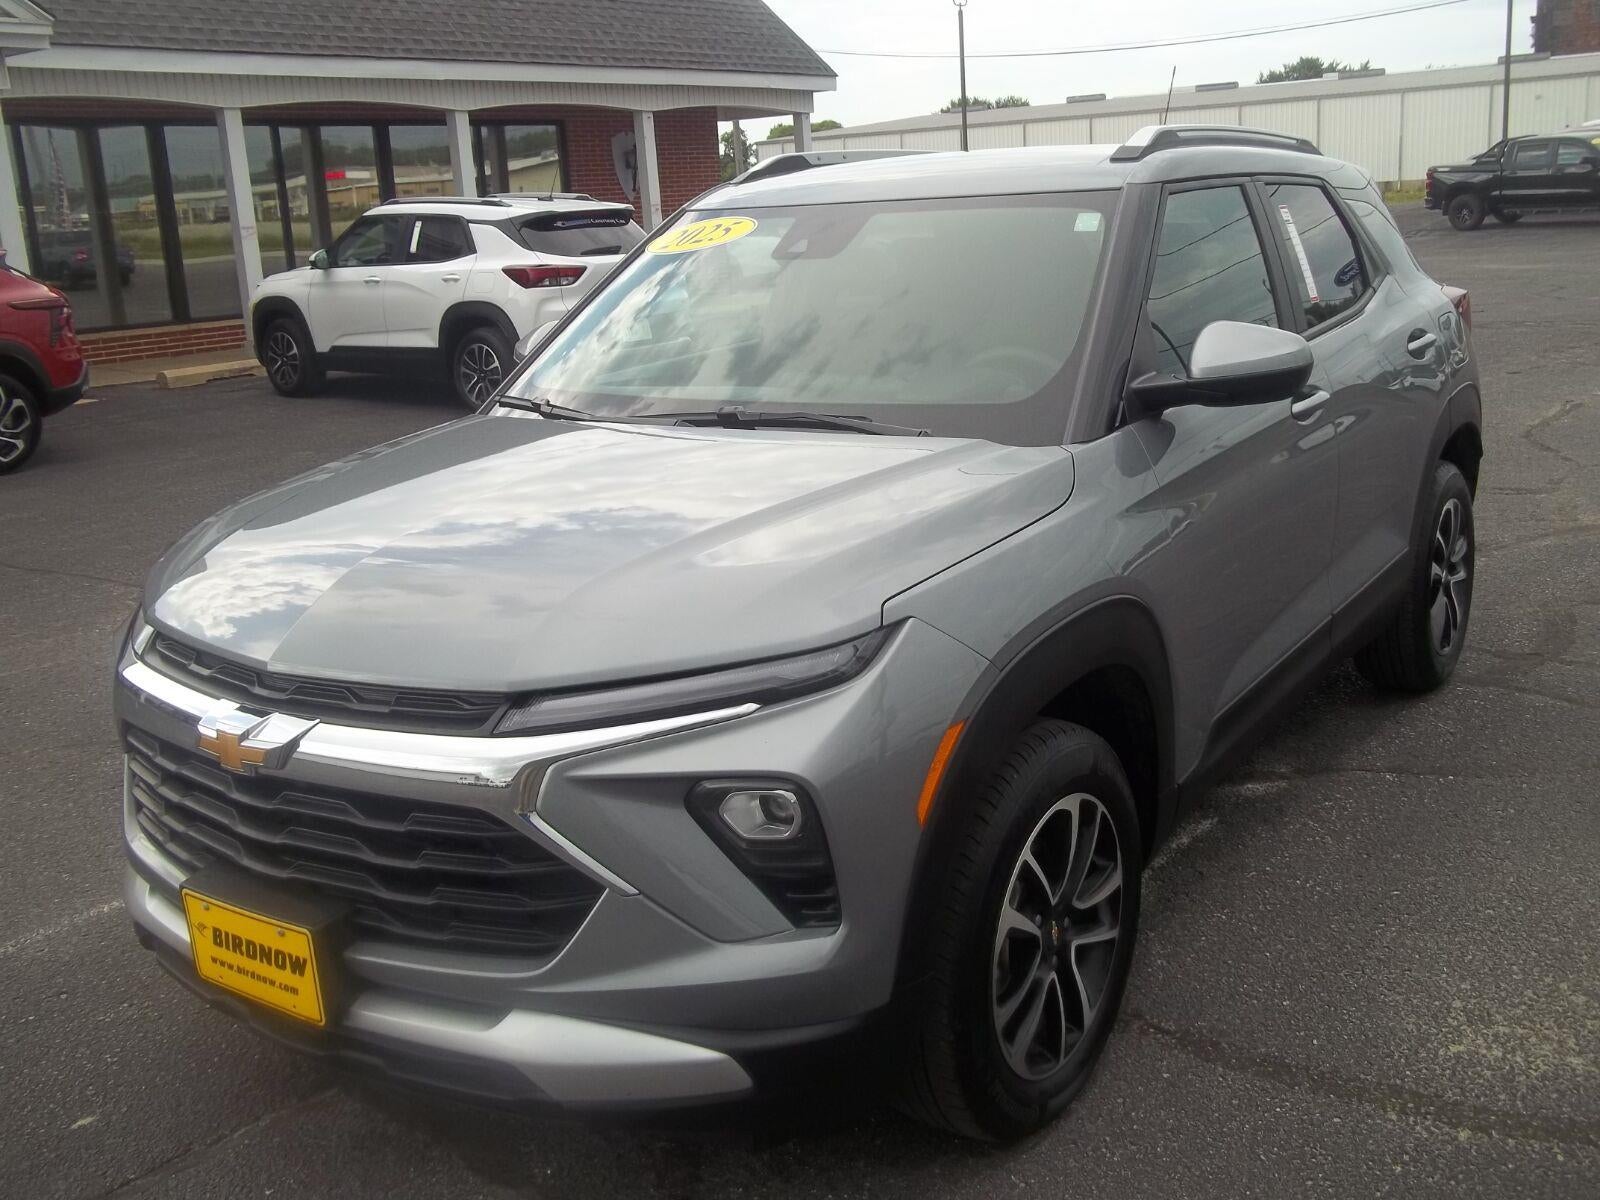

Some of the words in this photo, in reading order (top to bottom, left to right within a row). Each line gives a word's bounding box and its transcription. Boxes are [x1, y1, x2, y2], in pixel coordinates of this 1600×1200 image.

[661, 221, 742, 249] 2025
[212, 926, 307, 977] BIRDNOW
[210, 955, 299, 996] www.birdnow.com
